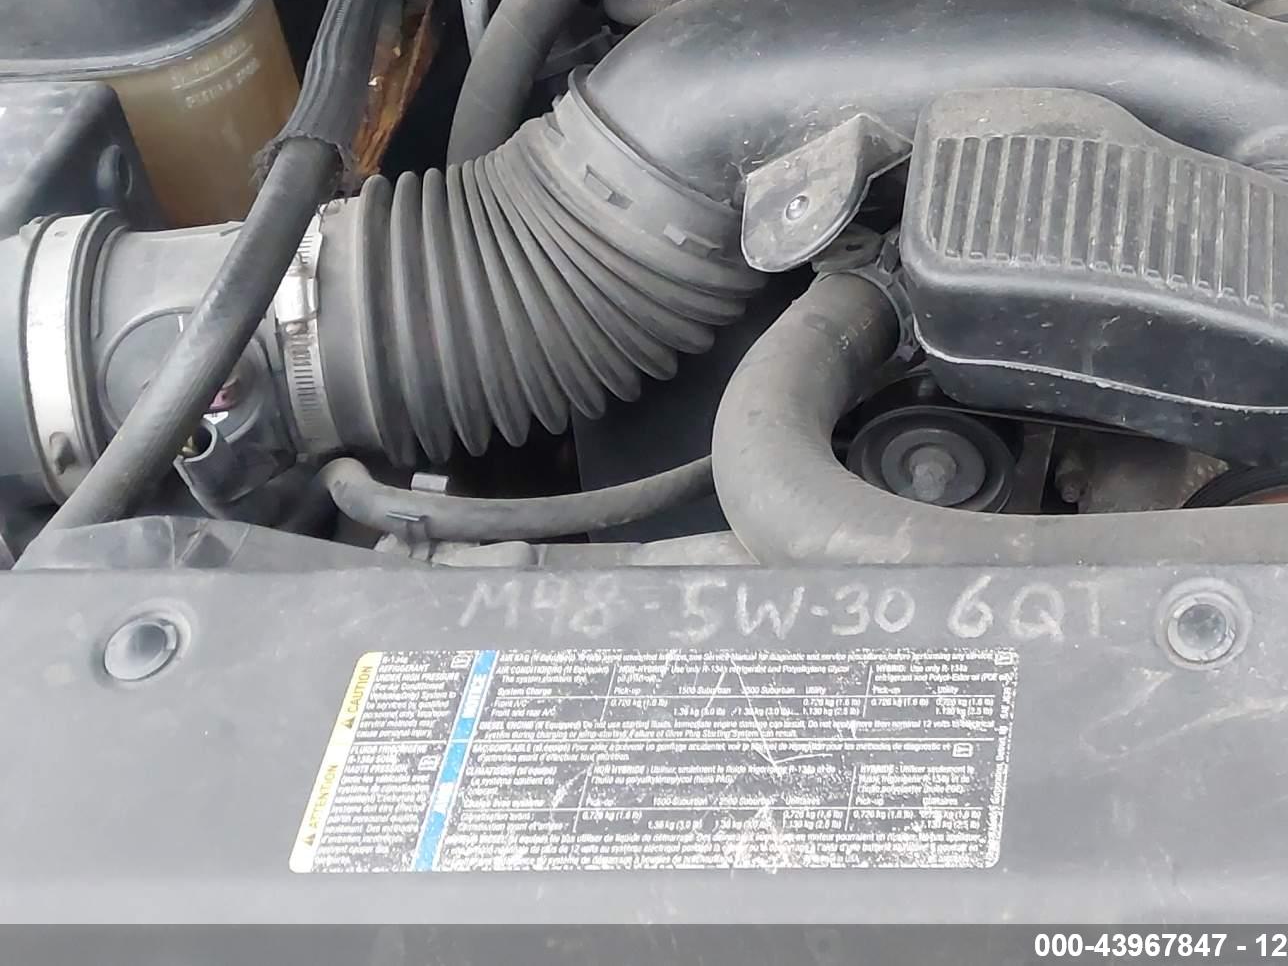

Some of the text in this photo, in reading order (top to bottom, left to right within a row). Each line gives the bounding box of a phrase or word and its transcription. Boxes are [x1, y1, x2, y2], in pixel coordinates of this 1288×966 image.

[347, 665, 373, 714] CAUTION
[498, 687, 525, 696] System
[614, 687, 641, 696] Pick-up
[760, 686, 795, 695] Suburban
[873, 686, 901, 695] Pick-up
[308, 764, 338, 830] ATTENTION
